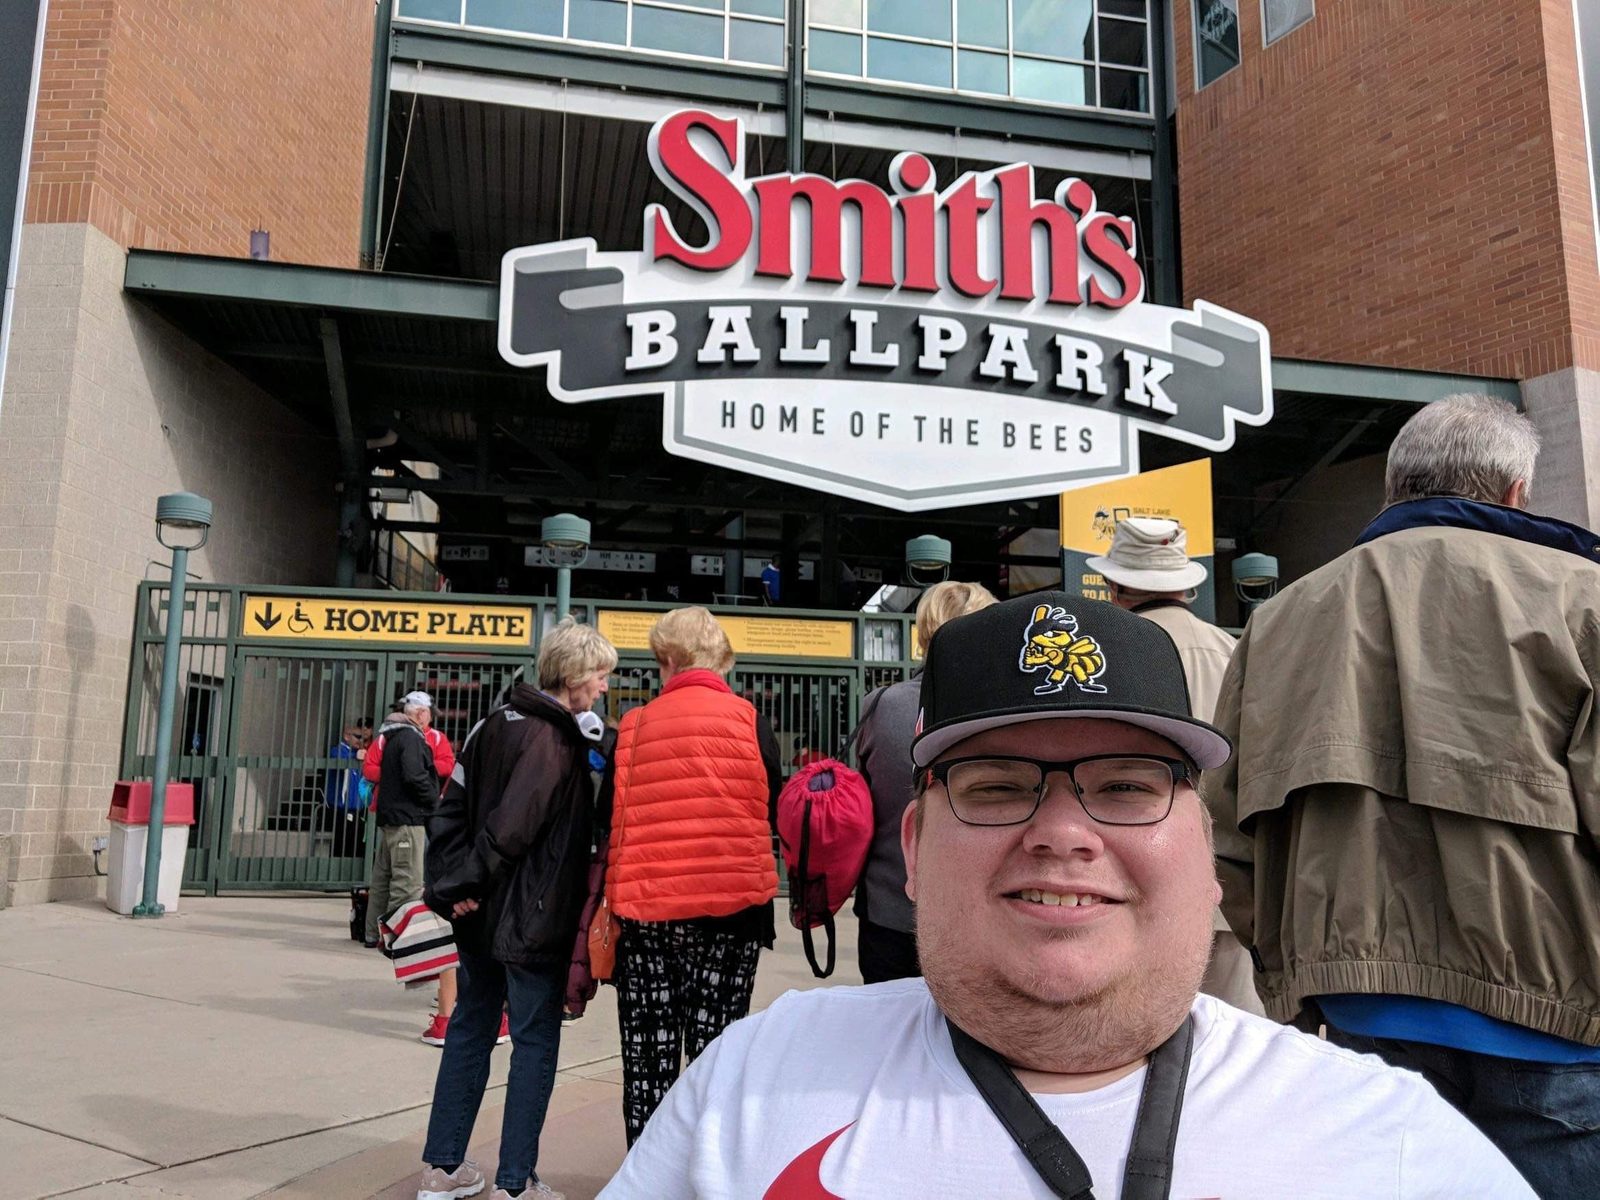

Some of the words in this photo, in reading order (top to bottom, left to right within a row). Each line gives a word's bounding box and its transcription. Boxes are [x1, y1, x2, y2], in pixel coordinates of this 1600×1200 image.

[654, 109, 1143, 310] Smith's
[624, 305, 1179, 416] BALLPARK
[720, 400, 826, 436] HOME
[849, 410, 892, 440] OF
[913, 415, 980, 447] THE
[1003, 421, 1094, 454] BEES
[1152, 508, 1170, 516] LAKE
[324, 607, 419, 633] HOME
[426, 611, 524, 637] PLATE
